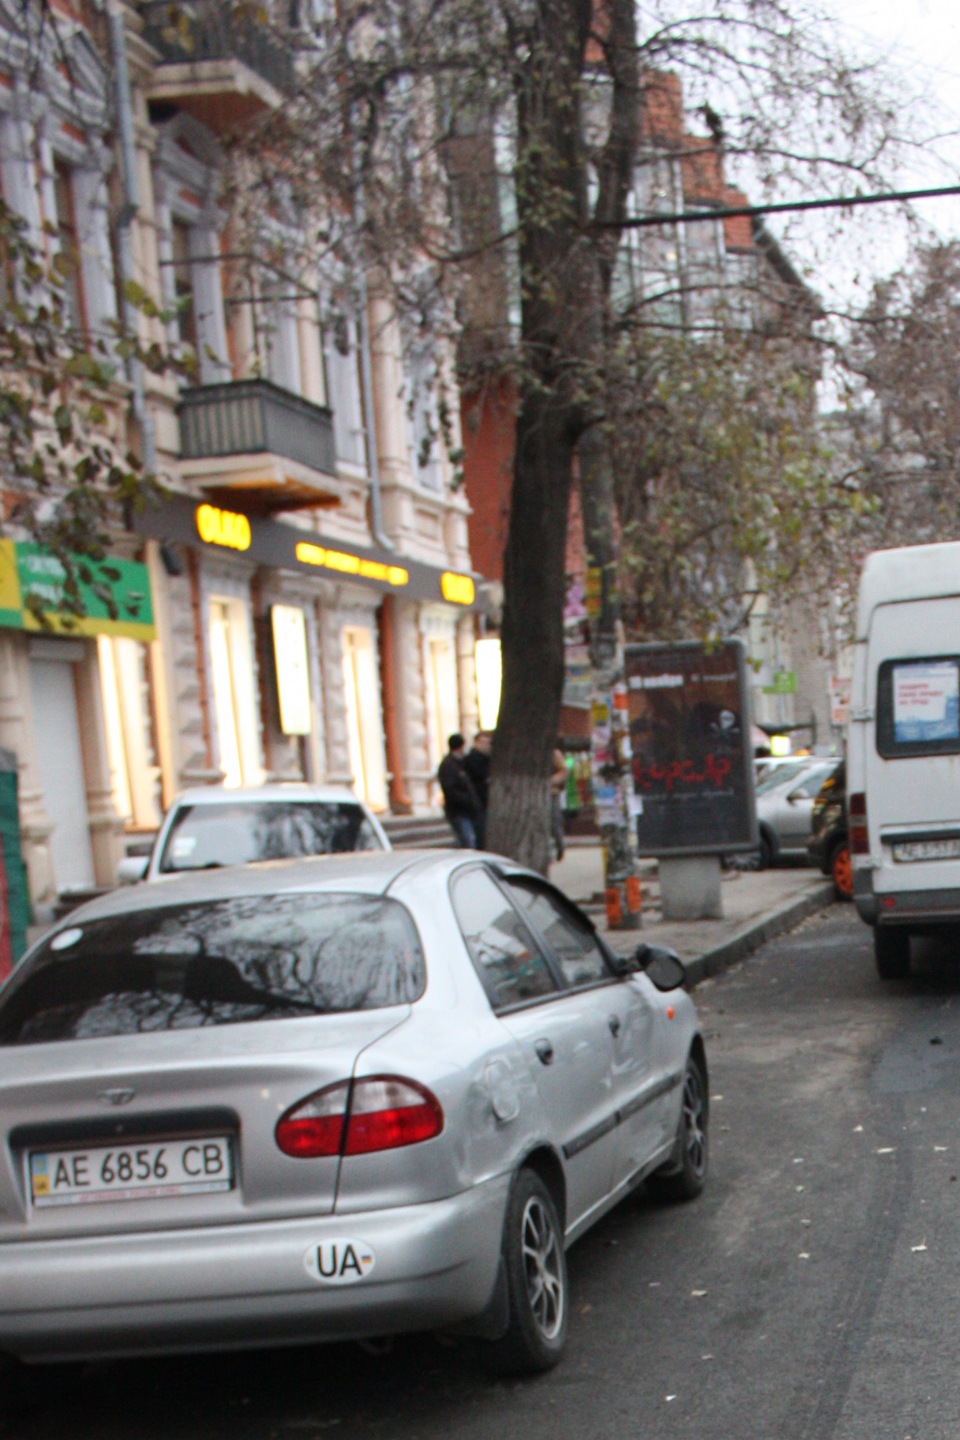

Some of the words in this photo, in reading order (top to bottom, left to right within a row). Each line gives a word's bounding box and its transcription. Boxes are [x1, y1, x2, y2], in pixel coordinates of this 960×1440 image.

[54, 1155, 90, 1188] AE
[101, 1149, 168, 1183] 6856
[182, 1144, 223, 1176] CB
[317, 1243, 363, 1277] UA
